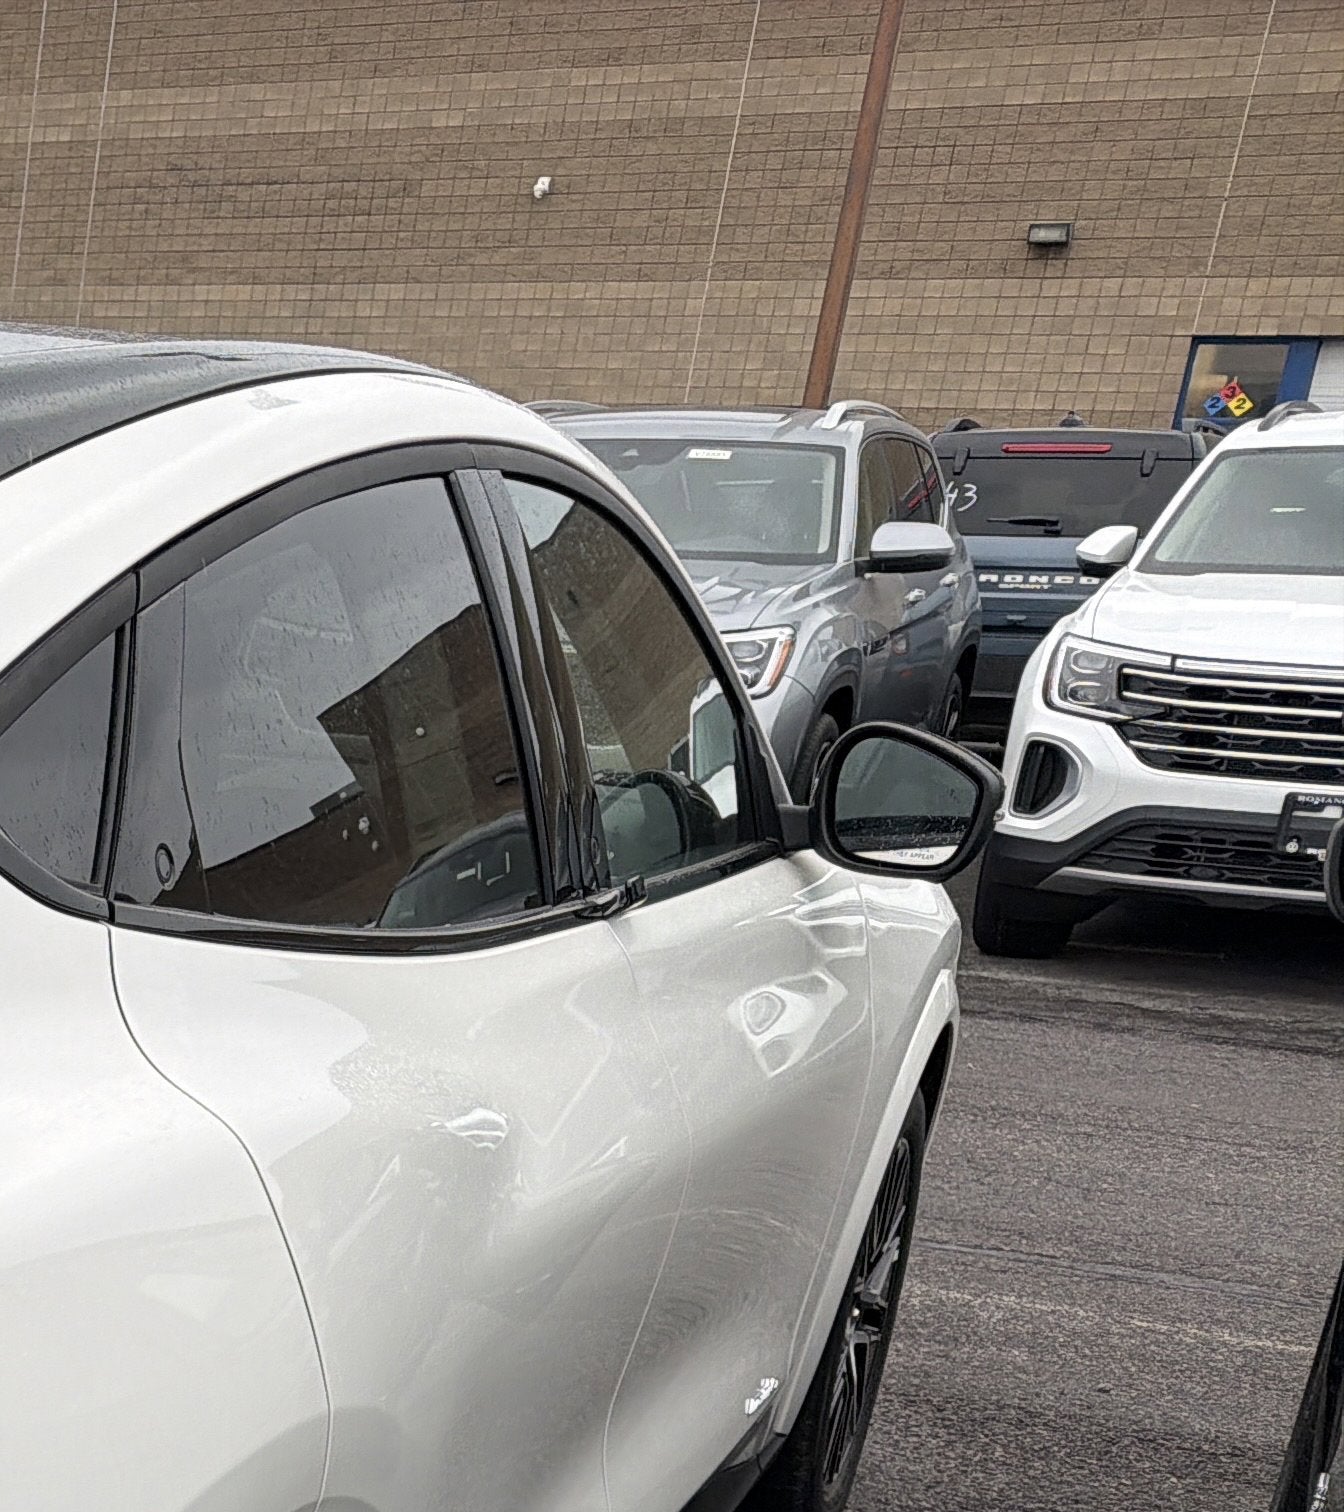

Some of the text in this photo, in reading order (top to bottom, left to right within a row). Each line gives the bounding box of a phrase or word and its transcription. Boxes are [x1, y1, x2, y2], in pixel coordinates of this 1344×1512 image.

[1224, 386, 1237, 399] 3
[1208, 397, 1220, 409] 2
[1234, 398, 1247, 409] 2
[978, 574, 1100, 584] RONCO
[1297, 795, 1344, 804] ROMAN
